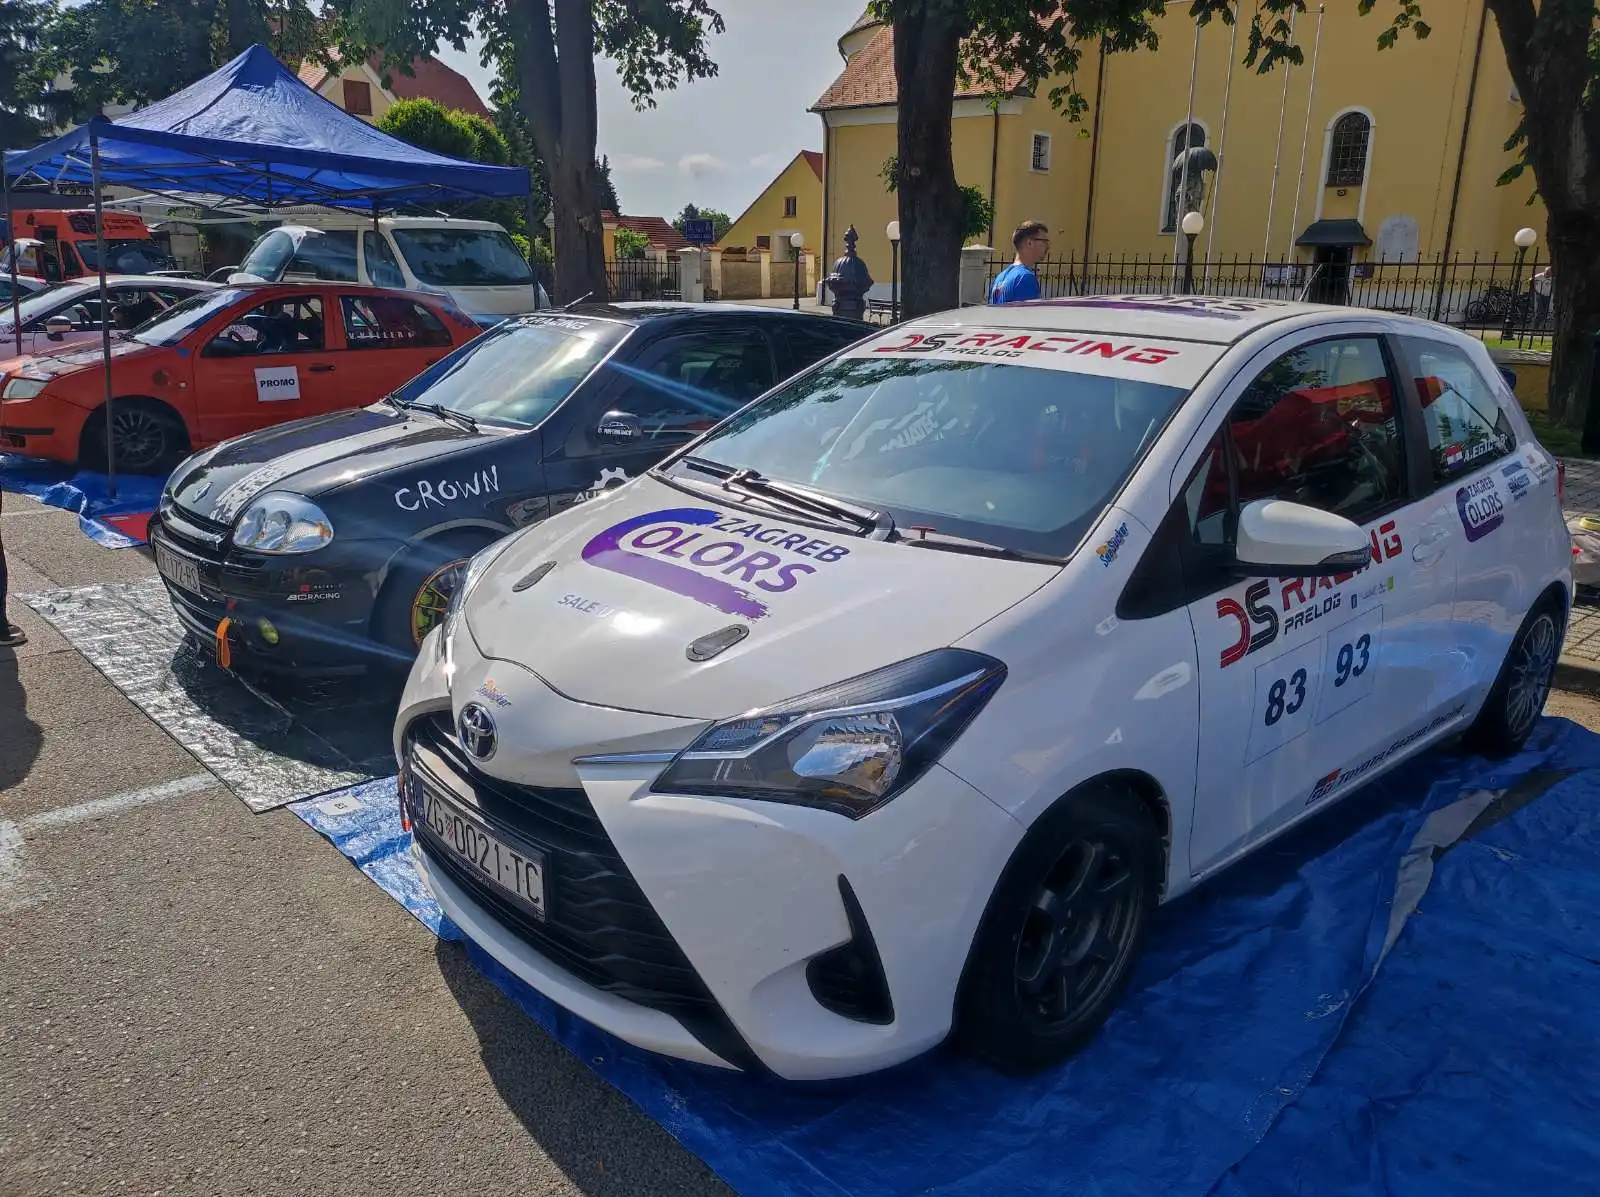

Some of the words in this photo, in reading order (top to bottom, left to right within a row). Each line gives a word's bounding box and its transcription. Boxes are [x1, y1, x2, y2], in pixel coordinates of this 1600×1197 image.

[934, 345, 1024, 359] PRELOG
[955, 332, 1181, 366] RACING
[259, 378, 296, 388] PROMO
[393, 463, 501, 512] CROWN
[573, 489, 606, 503] AU
[1467, 476, 1496, 498] ZAGREB
[712, 512, 851, 563] ZAGREB
[557, 594, 600, 613] SALE
[1283, 592, 1342, 636] PRELOG
[1334, 632, 1372, 689] 93
[1264, 667, 1308, 727] 83
[423, 788, 445, 838] ZG
